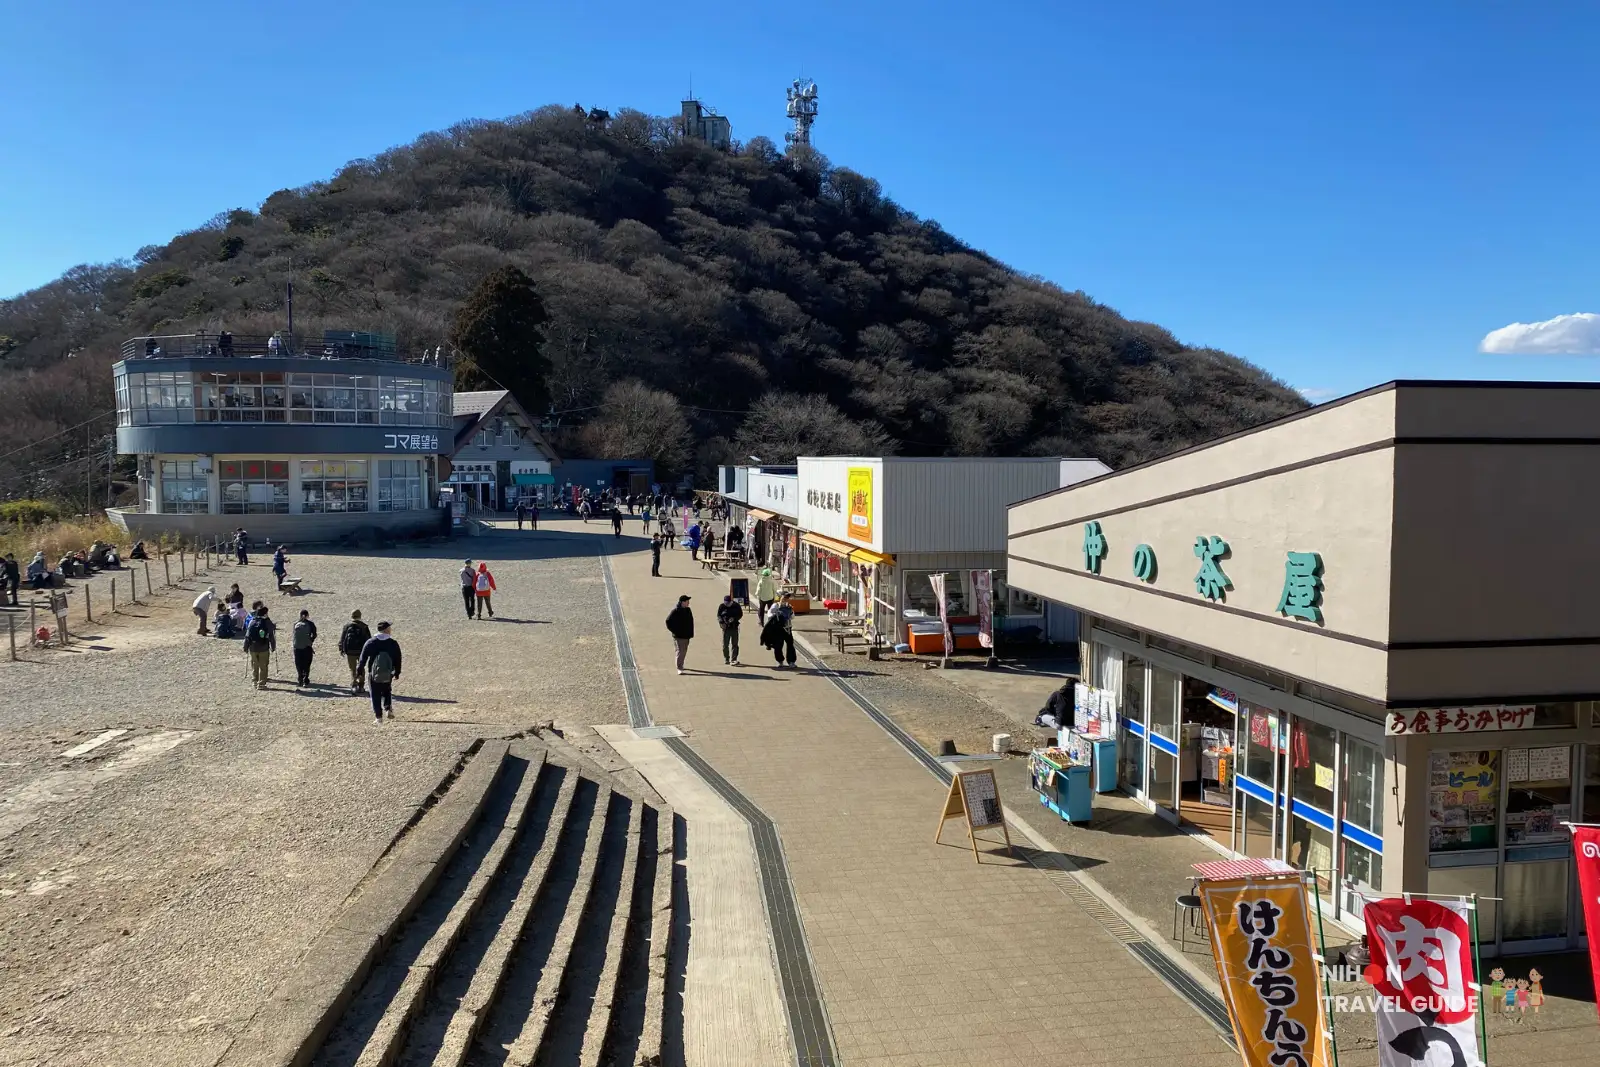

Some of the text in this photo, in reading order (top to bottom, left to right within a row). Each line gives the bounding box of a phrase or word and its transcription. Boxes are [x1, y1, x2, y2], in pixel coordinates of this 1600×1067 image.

[384, 434, 438, 450] コマ展望台
[1083, 520, 1325, 624] 仲の茶屋
[1449, 770, 1494, 787] ビール
